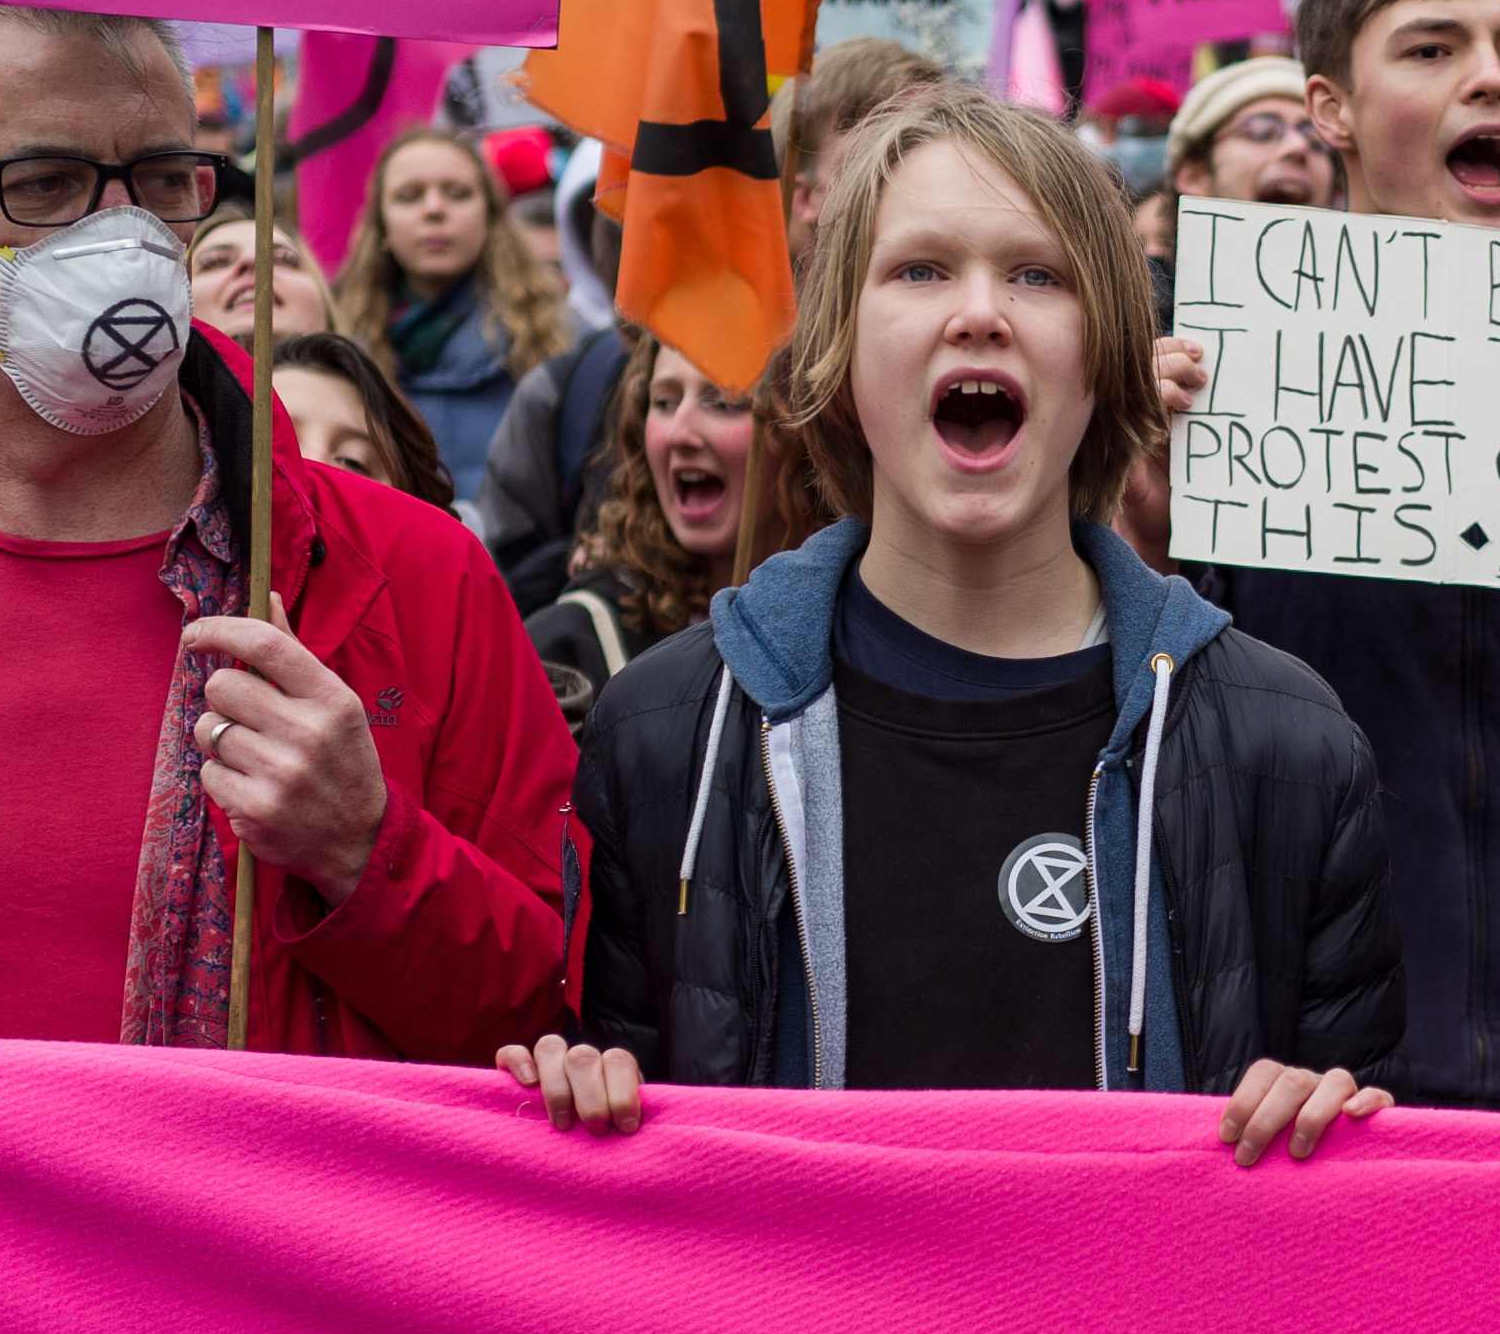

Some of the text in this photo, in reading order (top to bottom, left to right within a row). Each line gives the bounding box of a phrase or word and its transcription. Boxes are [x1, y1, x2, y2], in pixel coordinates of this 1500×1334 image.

[1178, 210, 1245, 308] I
[1256, 217, 1443, 320] CAN'T
[1178, 322, 1248, 417] I
[1273, 329, 1456, 427] HAVE
[1185, 420, 1466, 495] PROTEST
[1183, 494, 1437, 567] THIS
